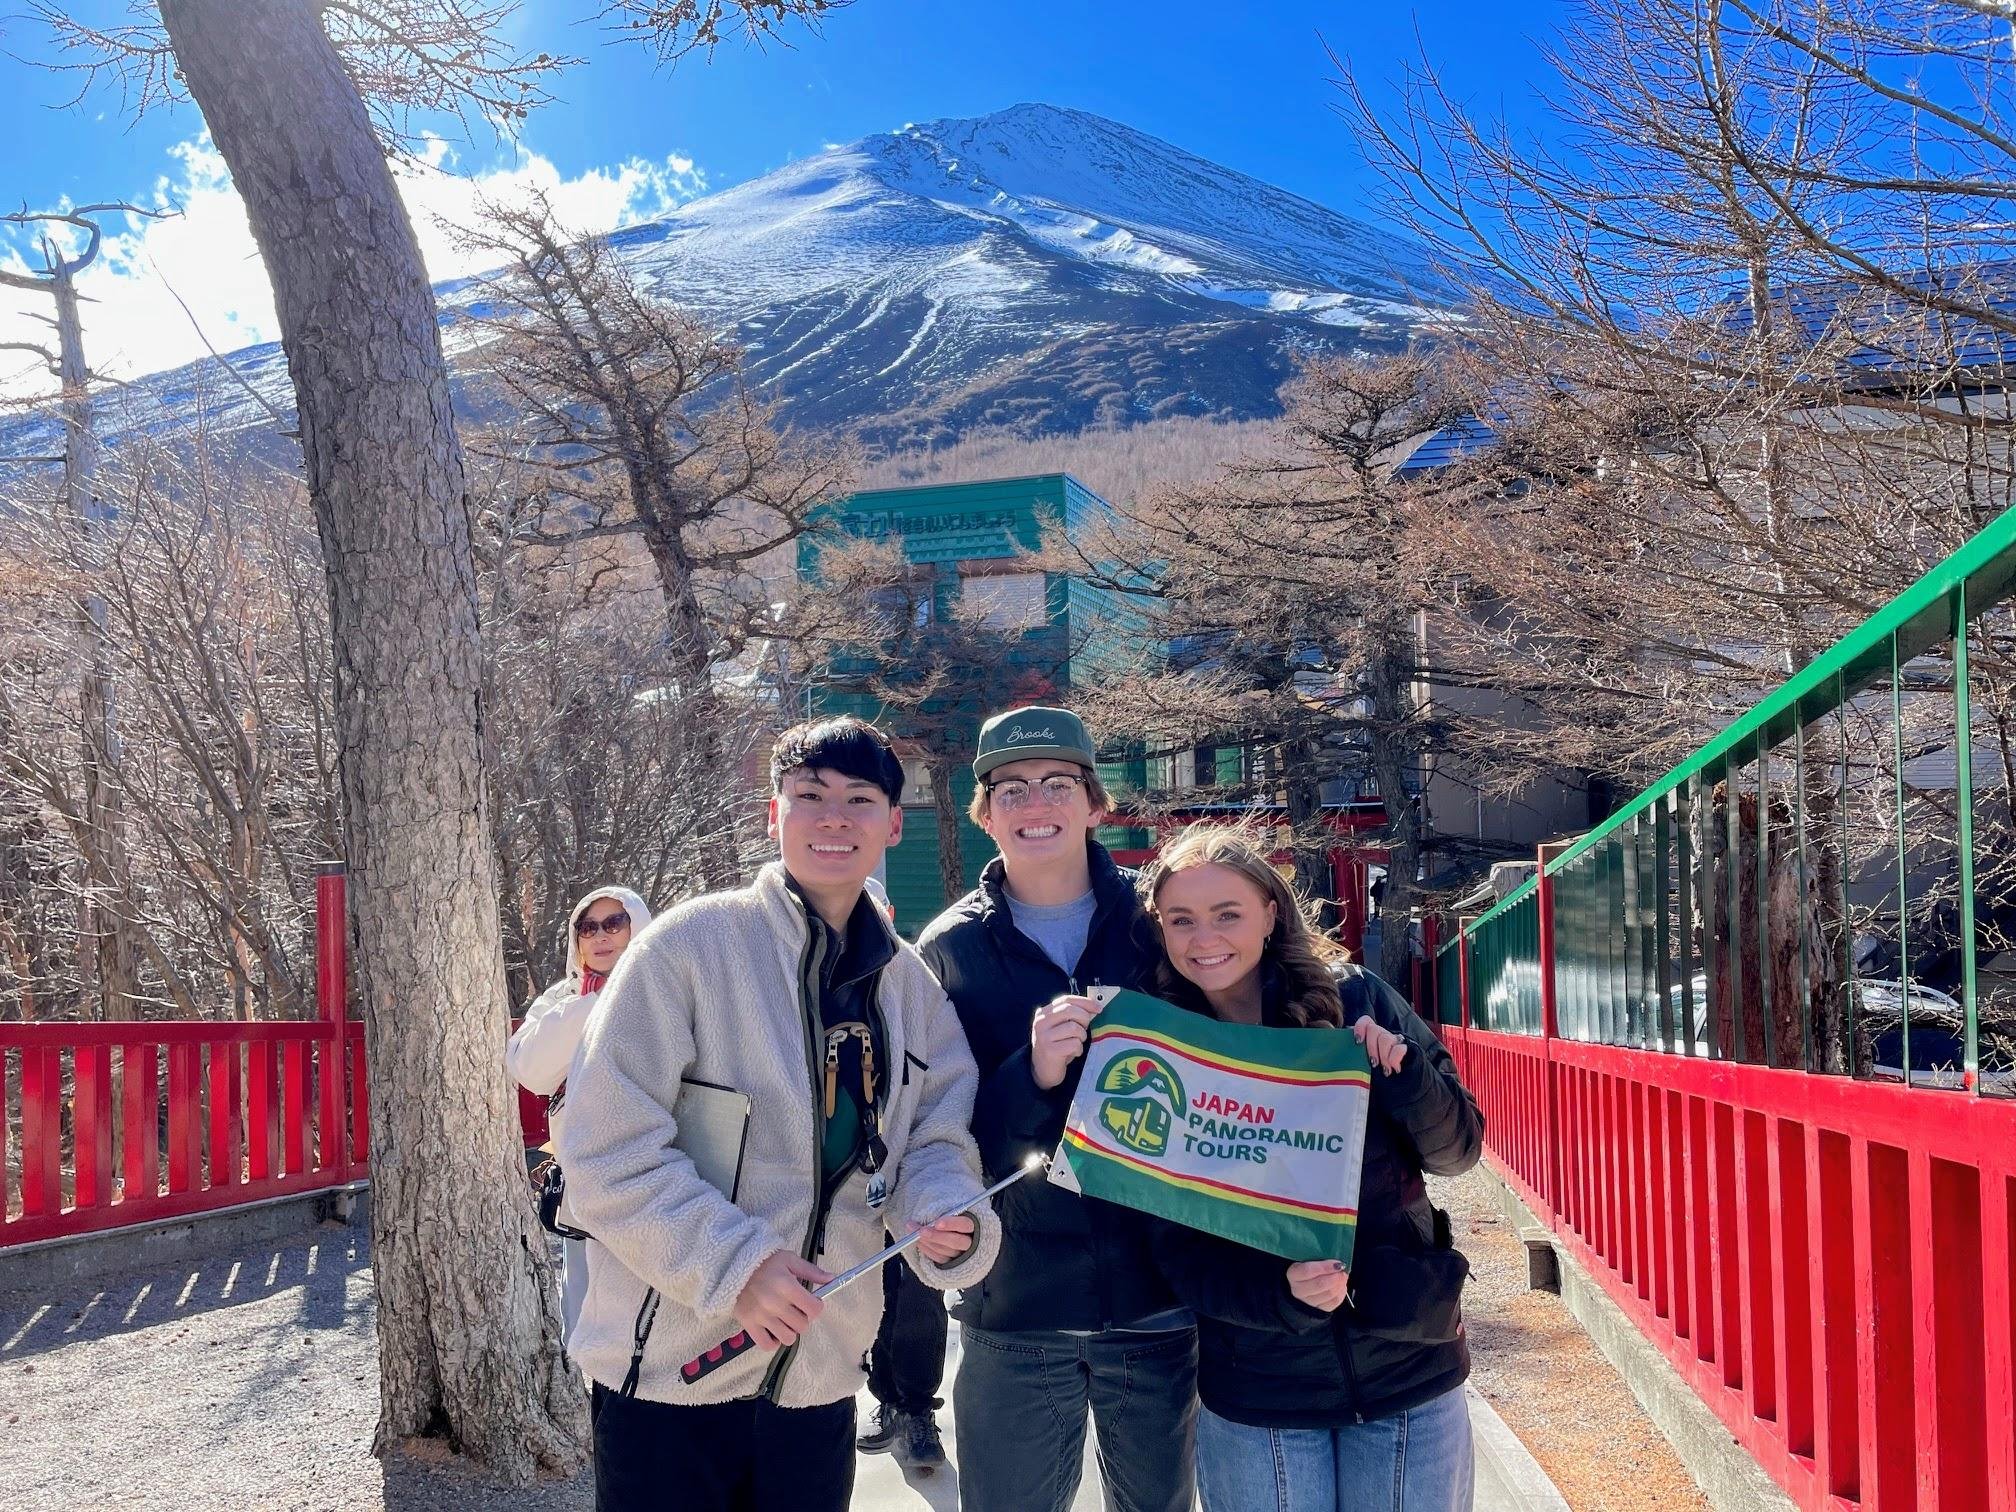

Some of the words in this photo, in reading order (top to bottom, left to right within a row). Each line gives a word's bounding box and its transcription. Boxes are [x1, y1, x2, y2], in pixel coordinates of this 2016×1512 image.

[1007, 725, 1056, 743] Brooks
[1192, 1092, 1274, 1123] JAPAN
[1188, 1113, 1344, 1154] PANORAMIC
[1183, 1134, 1267, 1164] TOURS
